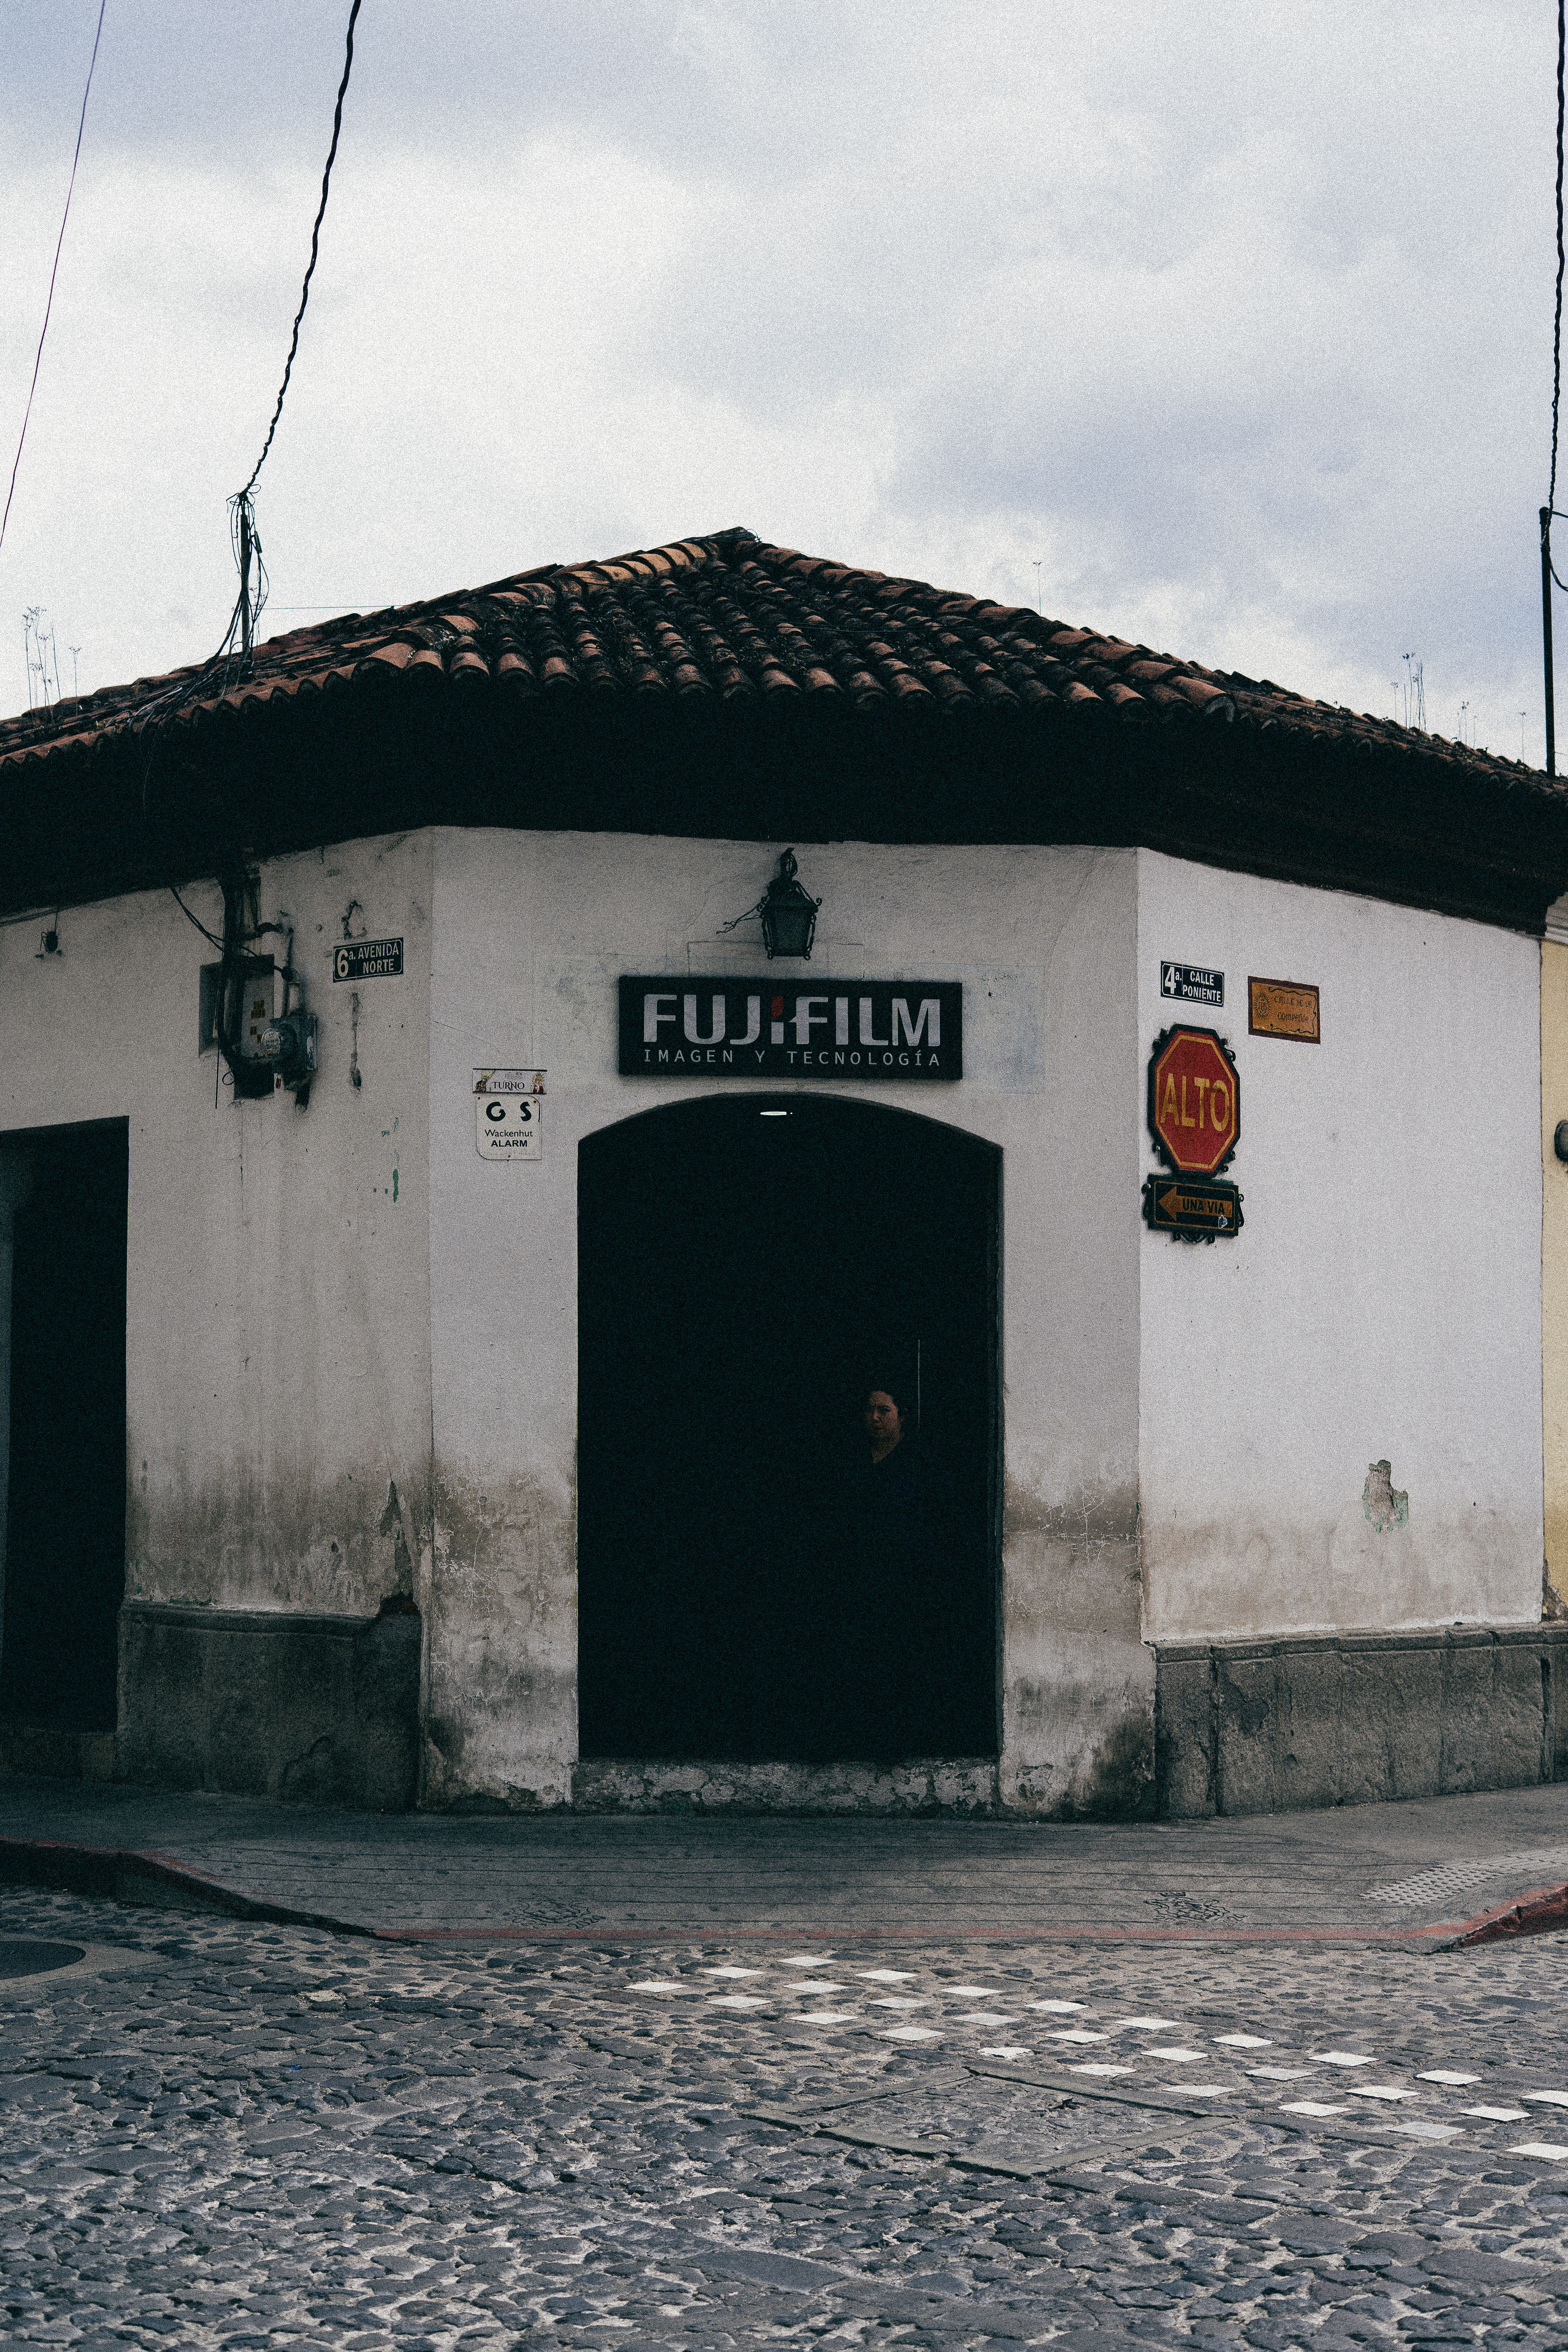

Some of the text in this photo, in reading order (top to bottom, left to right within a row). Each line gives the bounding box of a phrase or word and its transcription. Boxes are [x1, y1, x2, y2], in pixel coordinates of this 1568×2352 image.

[358, 943, 399, 960] AVENIDA
[363, 959, 394, 974] NORTE
[1191, 971, 1214, 985] CALLE
[1183, 984, 1221, 1002] PONIENTE
[1274, 996, 1294, 1006] CALLE
[643, 994, 940, 1046] FUJIFILM
[644, 1050, 940, 1066] IMAGEN Y TECNOLOGÍA
[492, 1081, 525, 1091] TURNO
[1161, 1073, 1230, 1131] ALTO
[1182, 1198, 1225, 1214] UNA VIA
